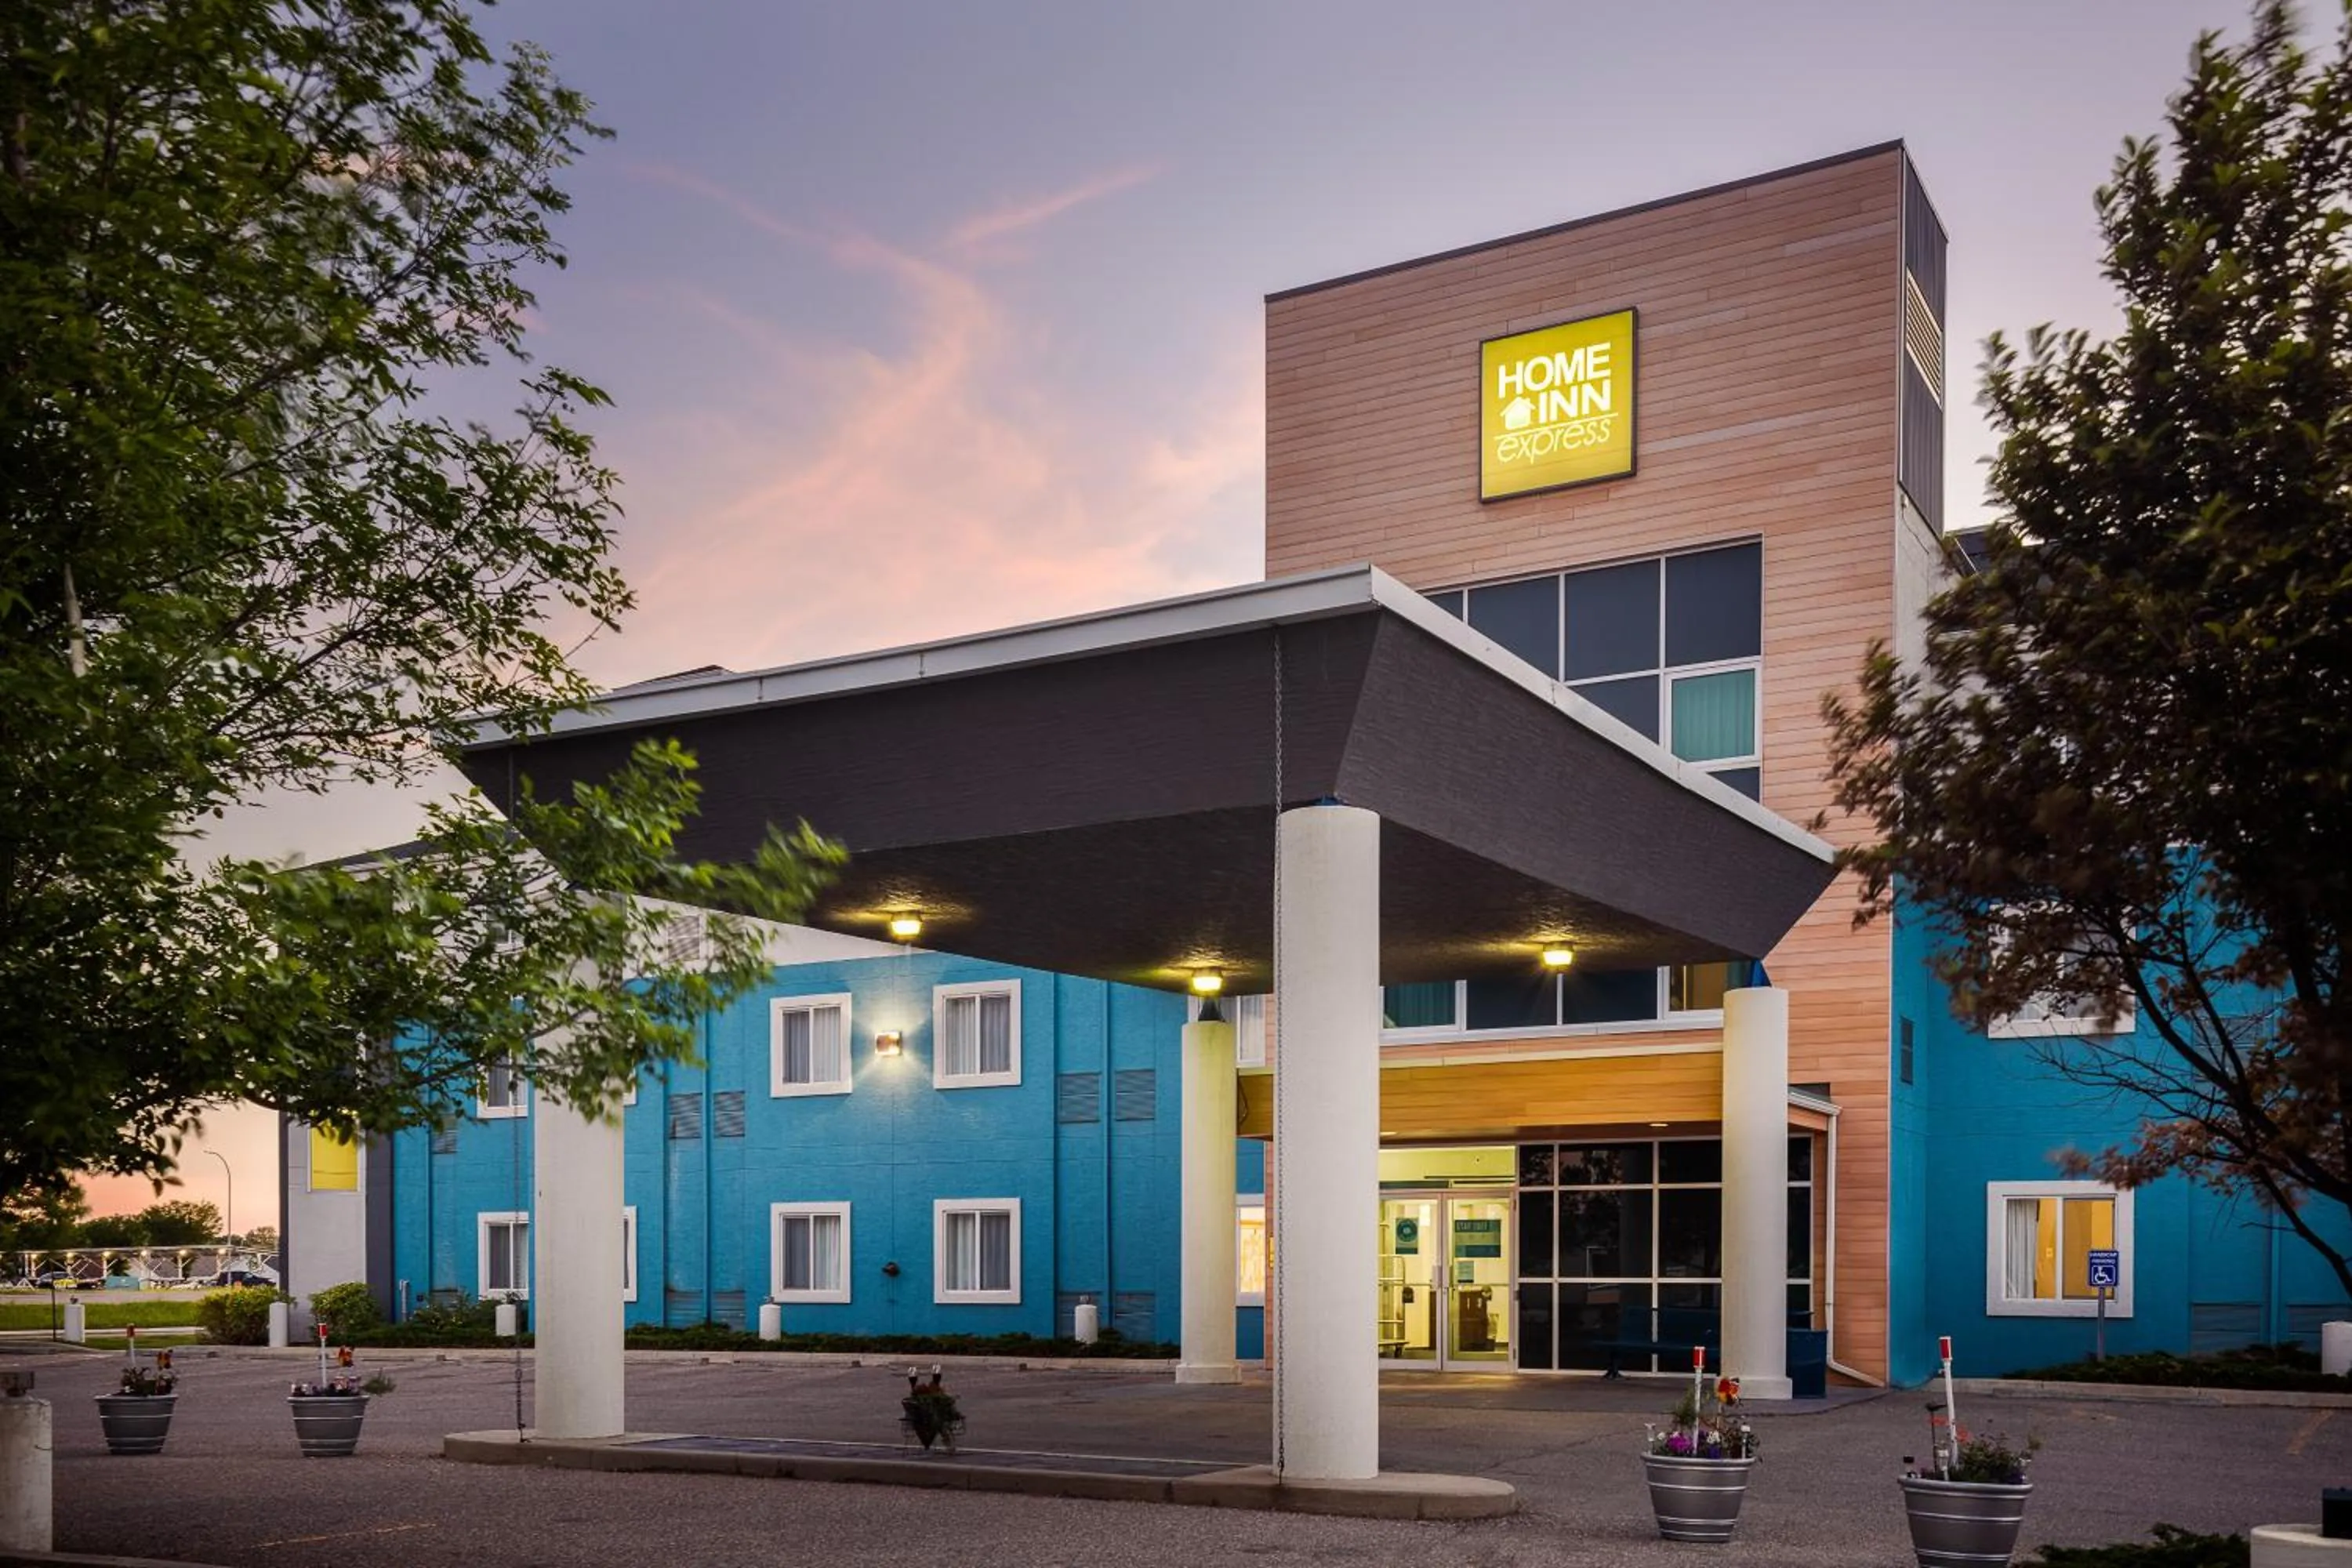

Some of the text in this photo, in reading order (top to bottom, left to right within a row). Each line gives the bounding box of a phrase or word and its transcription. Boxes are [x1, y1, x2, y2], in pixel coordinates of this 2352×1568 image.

[1498, 342, 1611, 399] HOME
[1539, 379, 1611, 423] INN
[1497, 418, 1611, 464] express
